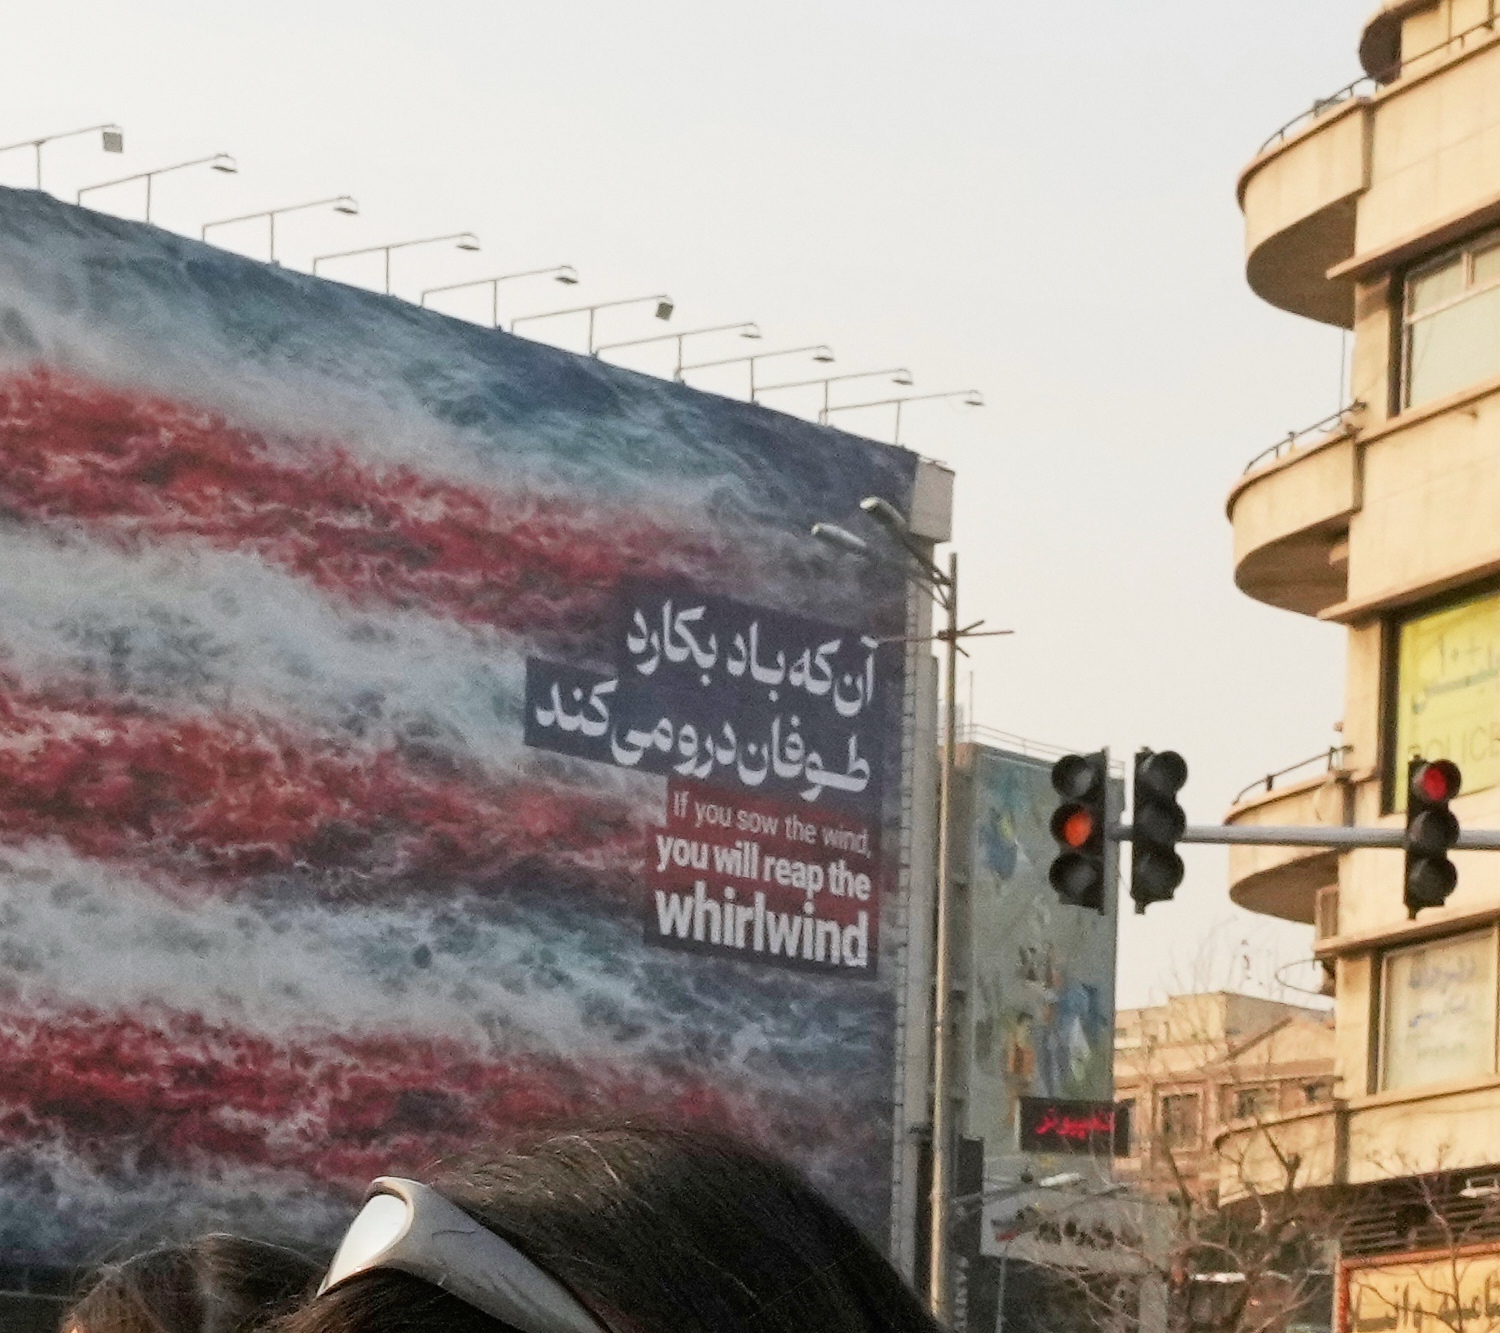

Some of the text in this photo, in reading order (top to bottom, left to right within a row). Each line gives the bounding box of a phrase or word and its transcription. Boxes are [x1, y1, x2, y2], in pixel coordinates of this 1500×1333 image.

[626, 599, 880, 717] آن که باد بکارد
[534, 677, 618, 738] کند
[736, 713, 870, 801] طوفان
[672, 790, 873, 860] If you sow the wind,
[655, 833, 872, 901] you will reap the
[654, 880, 870, 969] whirlwind
